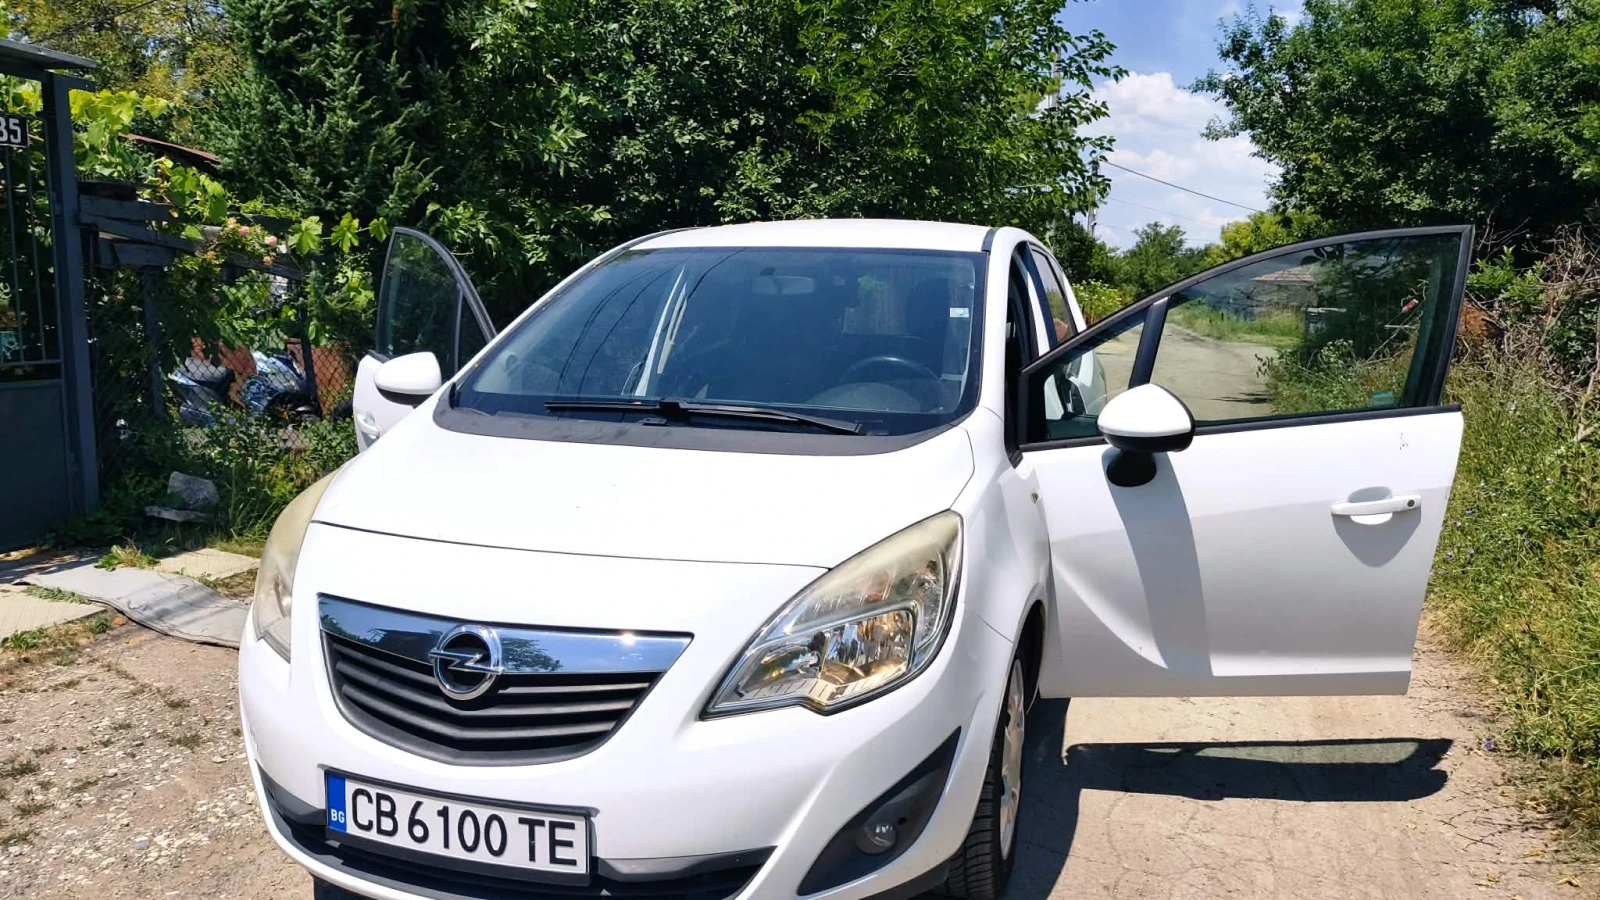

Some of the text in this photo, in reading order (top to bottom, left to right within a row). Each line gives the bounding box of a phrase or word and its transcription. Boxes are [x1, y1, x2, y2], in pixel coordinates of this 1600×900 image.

[331, 809, 345, 824] BG
[351, 788, 577, 866] CB 6100 TE
